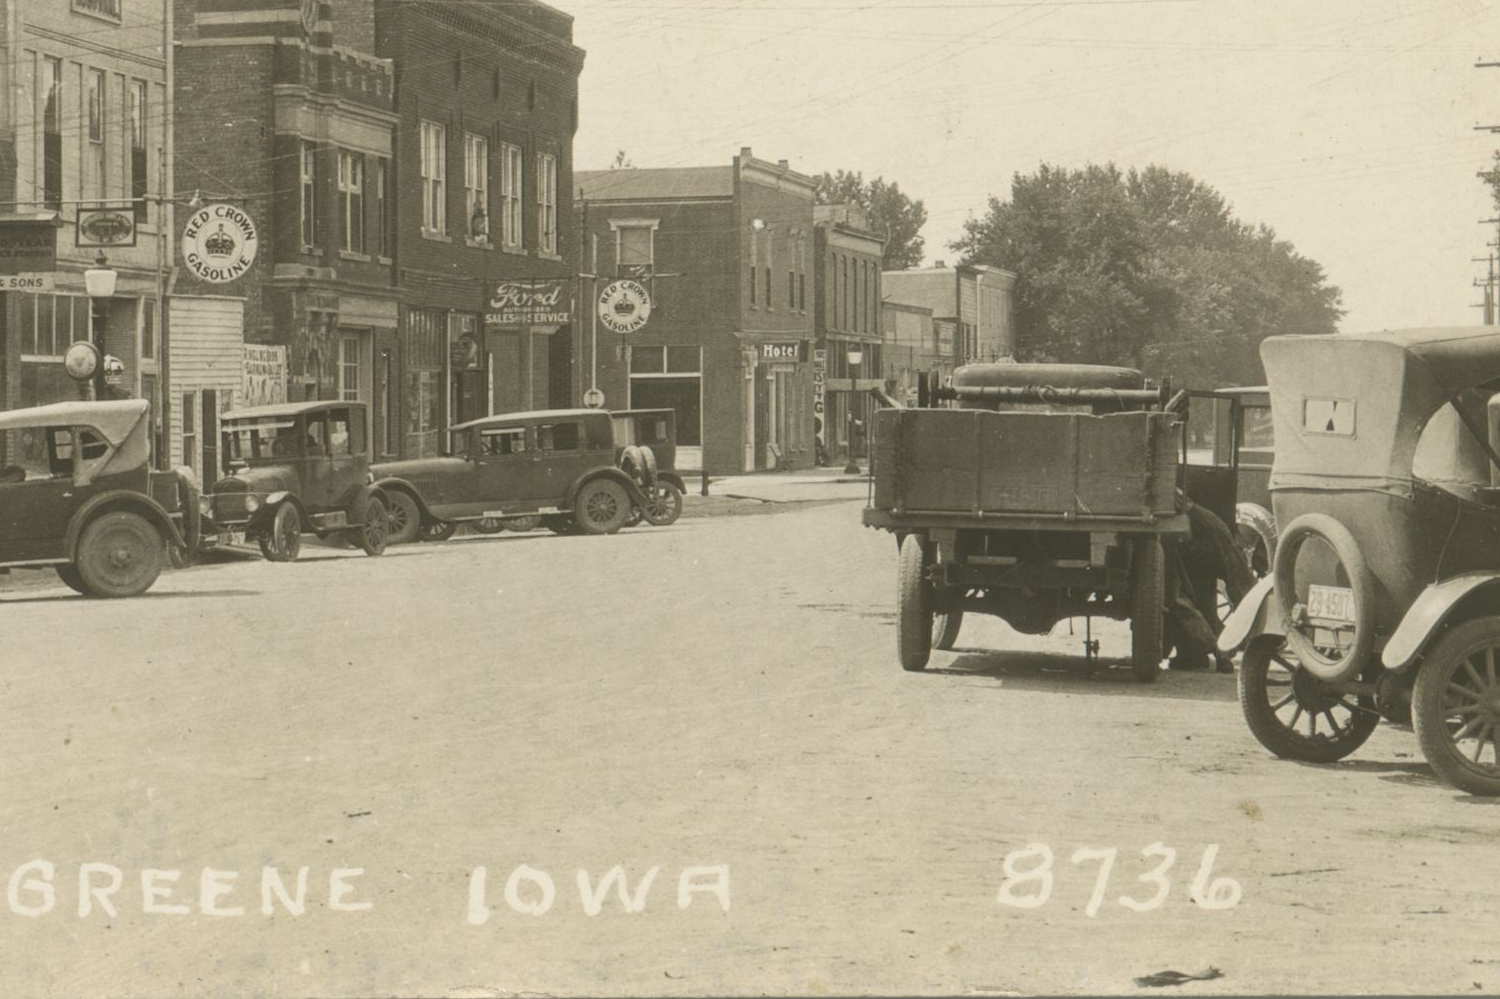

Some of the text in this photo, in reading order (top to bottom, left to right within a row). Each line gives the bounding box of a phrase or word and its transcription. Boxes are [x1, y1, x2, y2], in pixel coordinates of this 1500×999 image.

[185, 206, 255, 241] RED CROWN
[187, 253, 251, 280] GASOLINE
[9, 278, 44, 288] SONS
[600, 282, 648, 304] RED CROWN
[490, 282, 561, 309] Ford
[485, 313, 515, 324] SALES
[527, 312, 569, 323] SERVICE
[602, 313, 646, 331] GASOLINE
[763, 344, 798, 357] Hotel
